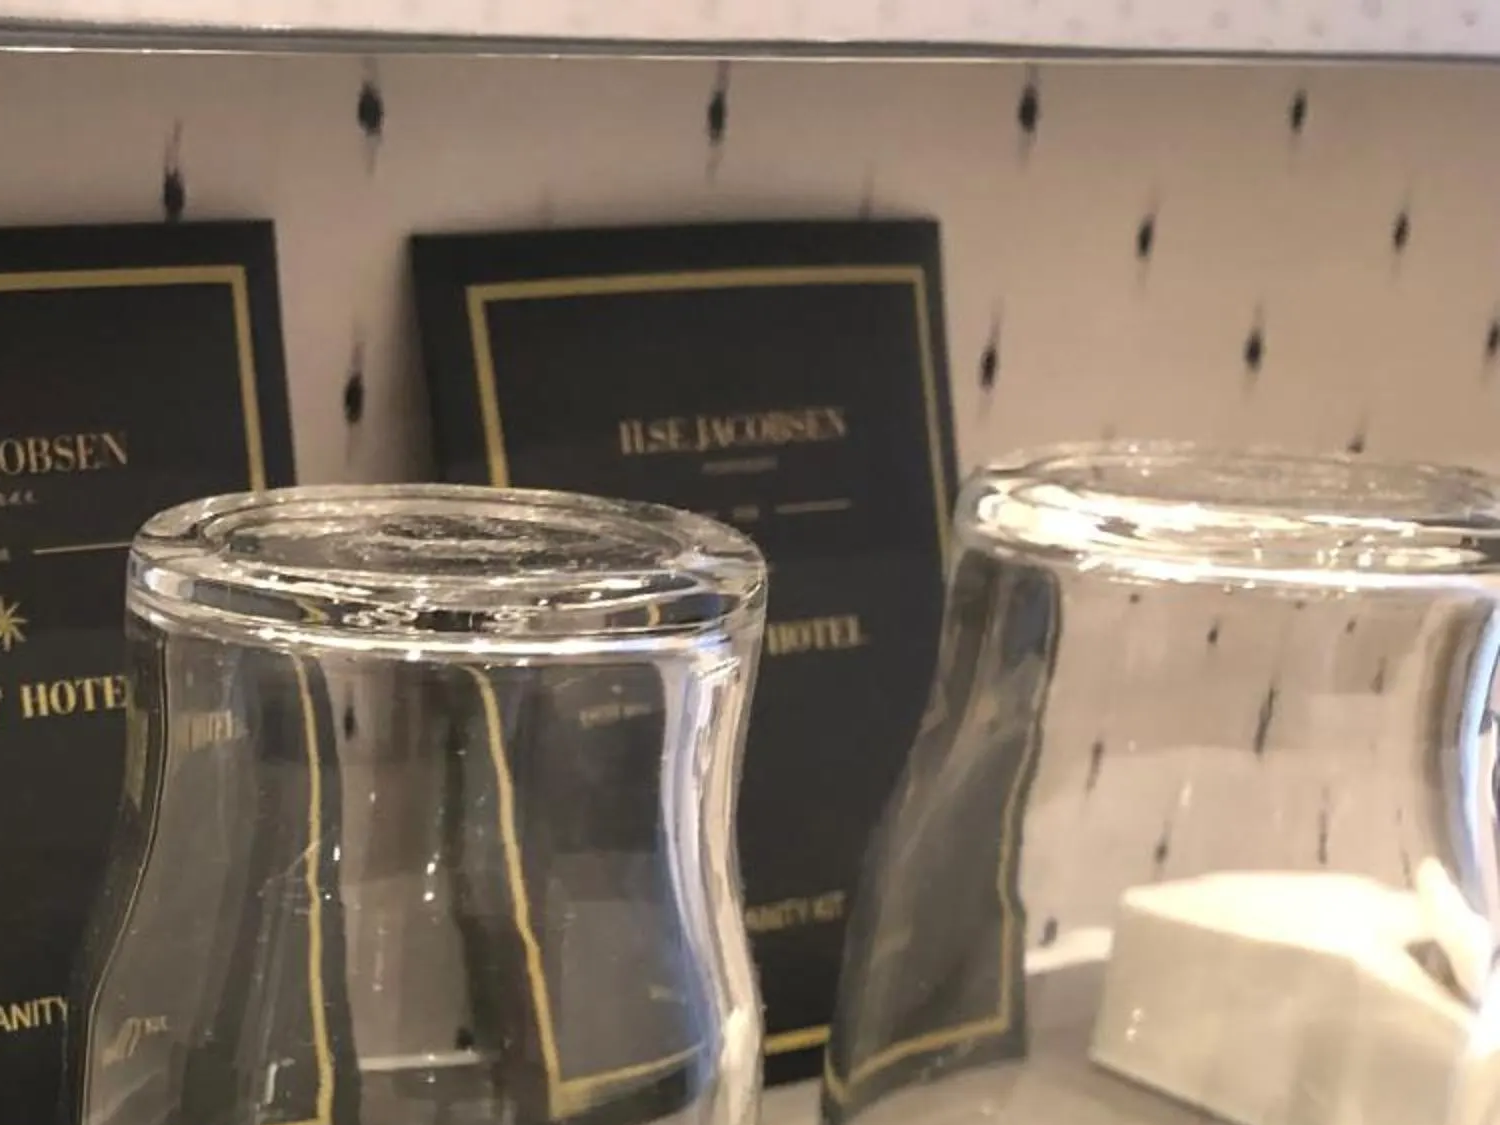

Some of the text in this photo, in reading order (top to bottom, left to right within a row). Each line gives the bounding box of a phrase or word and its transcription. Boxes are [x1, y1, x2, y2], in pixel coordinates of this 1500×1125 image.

[619, 406, 848, 455] ILSE JACOBSEN
[768, 614, 871, 656] HOTEL
[20, 674, 128, 719] HOTE
